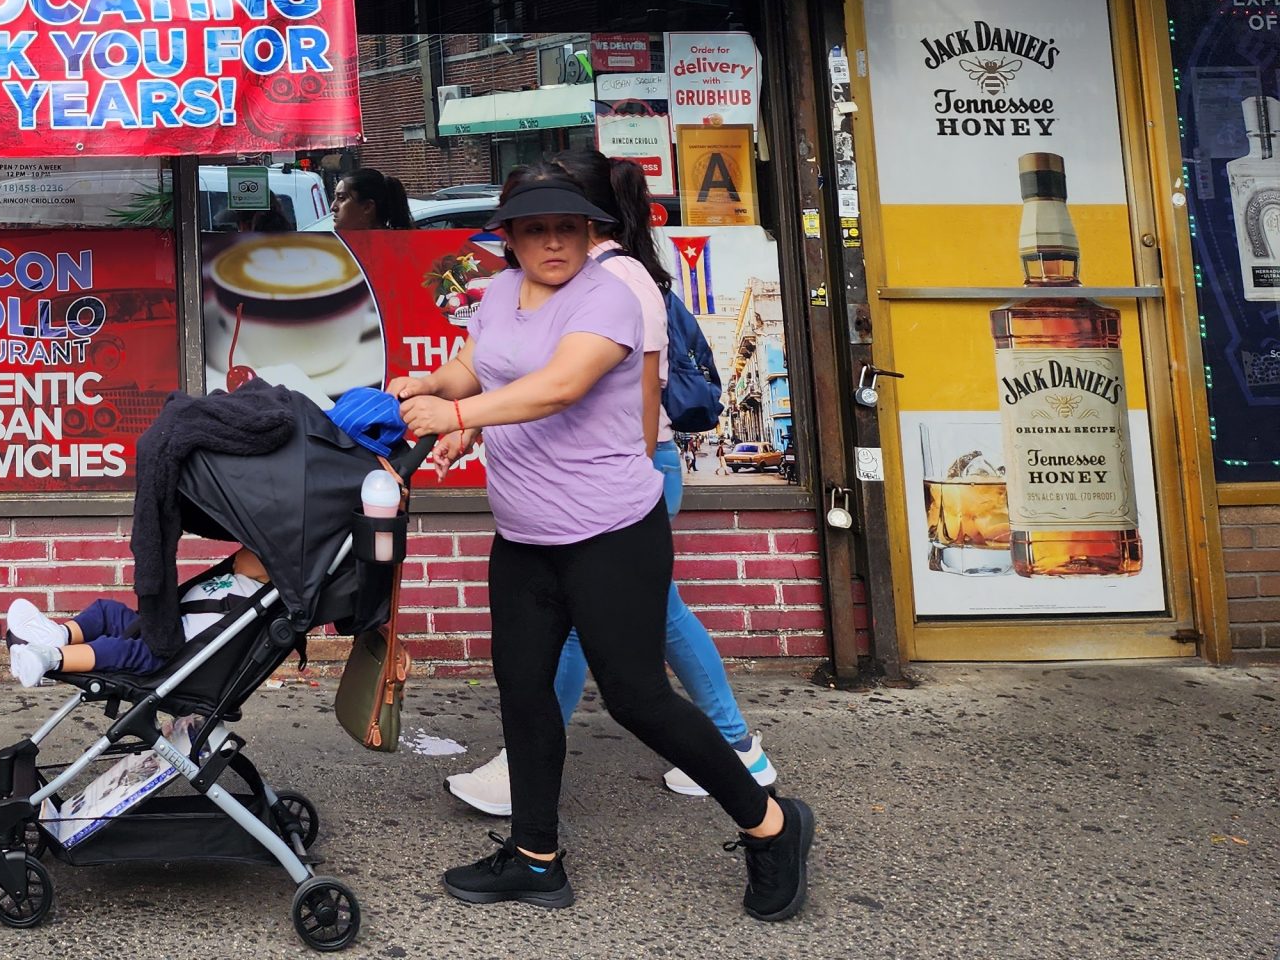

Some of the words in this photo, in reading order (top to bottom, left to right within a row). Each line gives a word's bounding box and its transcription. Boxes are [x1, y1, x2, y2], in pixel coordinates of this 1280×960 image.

[1248, 14, 1278, 31] OF
[49, 26, 188, 80] YOU
[204, 24, 334, 76] FOR
[690, 46, 715, 55] Order
[717, 46, 730, 55] for
[920, 28, 976, 69] JACK
[974, 20, 1060, 70] DANIEL'S
[673, 57, 754, 80] delivery
[702, 77, 721, 85] with
[1, 76, 238, 131] YEARS!
[675, 90, 752, 106] GRUBHUB
[933, 88, 1054, 114] Tennessee
[936, 118, 1056, 136] HONEY
[696, 152, 742, 202] A
[403, 336, 468, 366] THA
[1002, 367, 1049, 406] JACK
[1048, 359, 1123, 405] DANIEL'S
[1016, 426, 1071, 434] ORIGINAL
[1027, 449, 1106, 466] Tennessee
[1028, 470, 1108, 484] HONEY
[1093, 492, 1117, 501] PROOF)
[164, 746, 197, 776] TEENY
